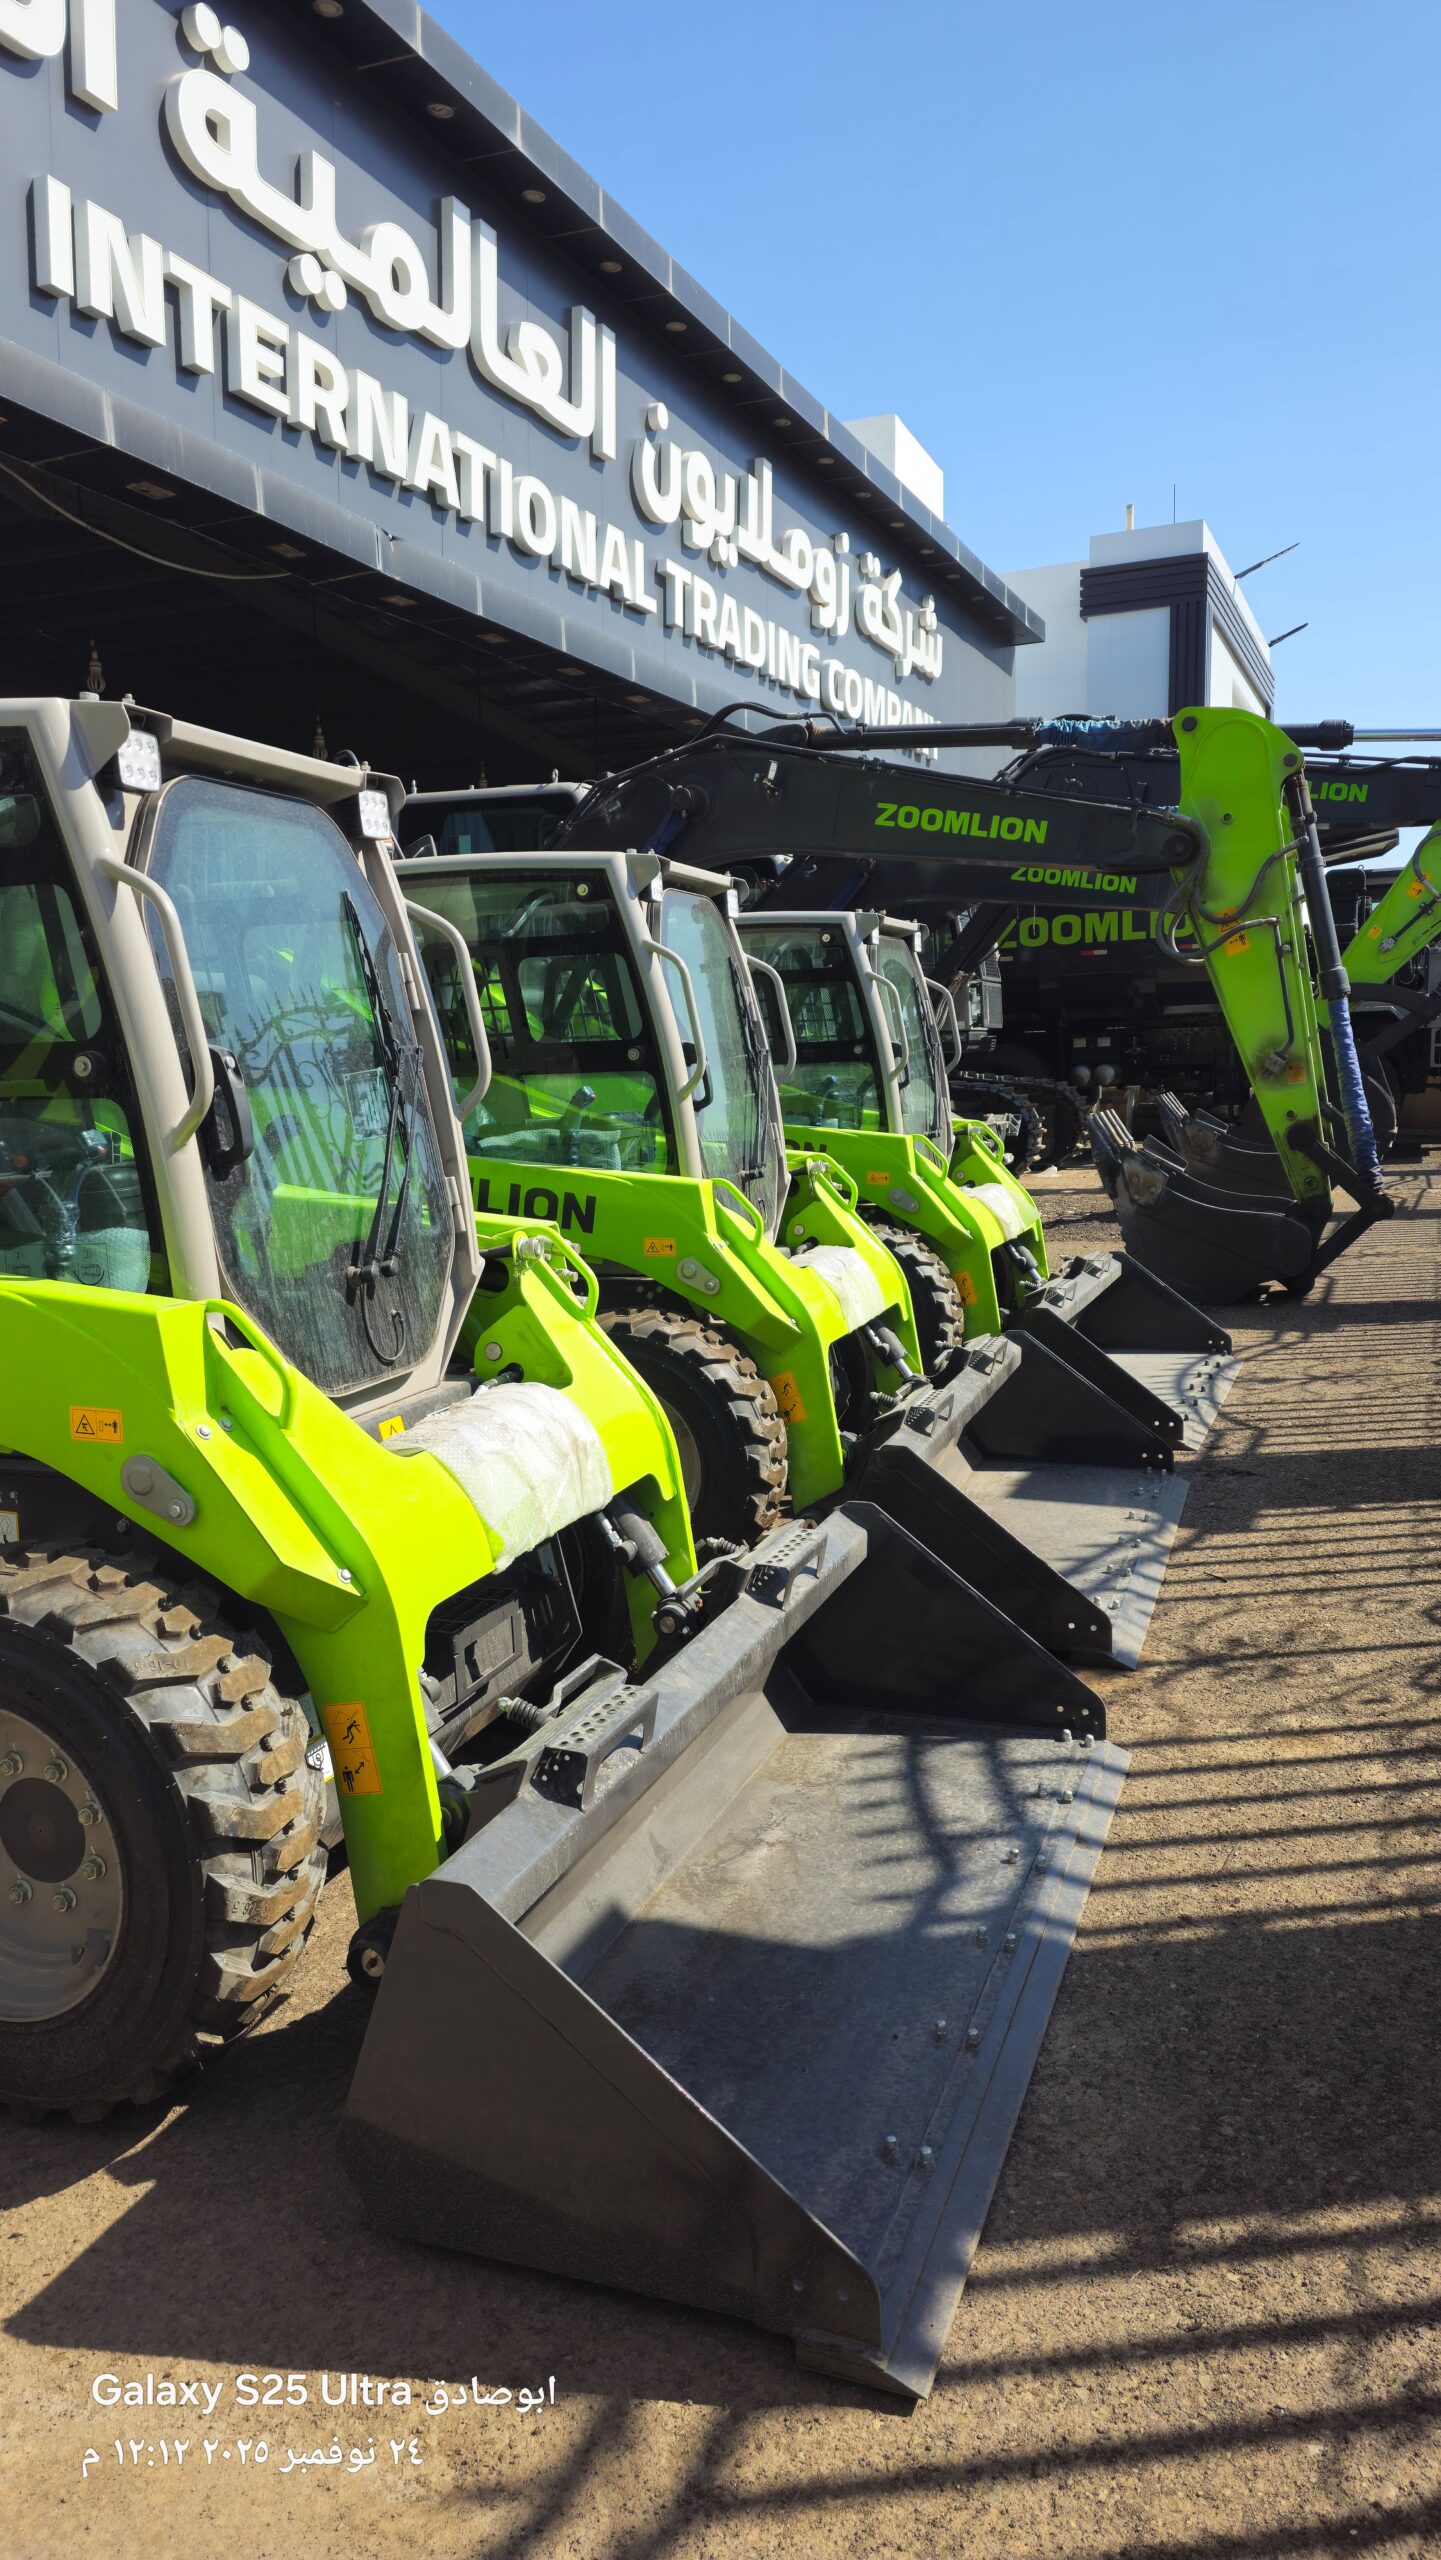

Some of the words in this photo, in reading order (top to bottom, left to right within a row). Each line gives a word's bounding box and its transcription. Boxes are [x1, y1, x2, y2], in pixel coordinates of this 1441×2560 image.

[165, 2, 616, 461] العالمية
[32, 174, 657, 614] INTERNATIONAL
[656, 557, 821, 700] TRADING
[632, 402, 850, 637] زومليون
[856, 551, 943, 678] شركة
[874, 802, 1048, 844] ZOOMLION
[1010, 866, 1137, 894] ZOOMLION
[469, 1176, 597, 1234] LION
